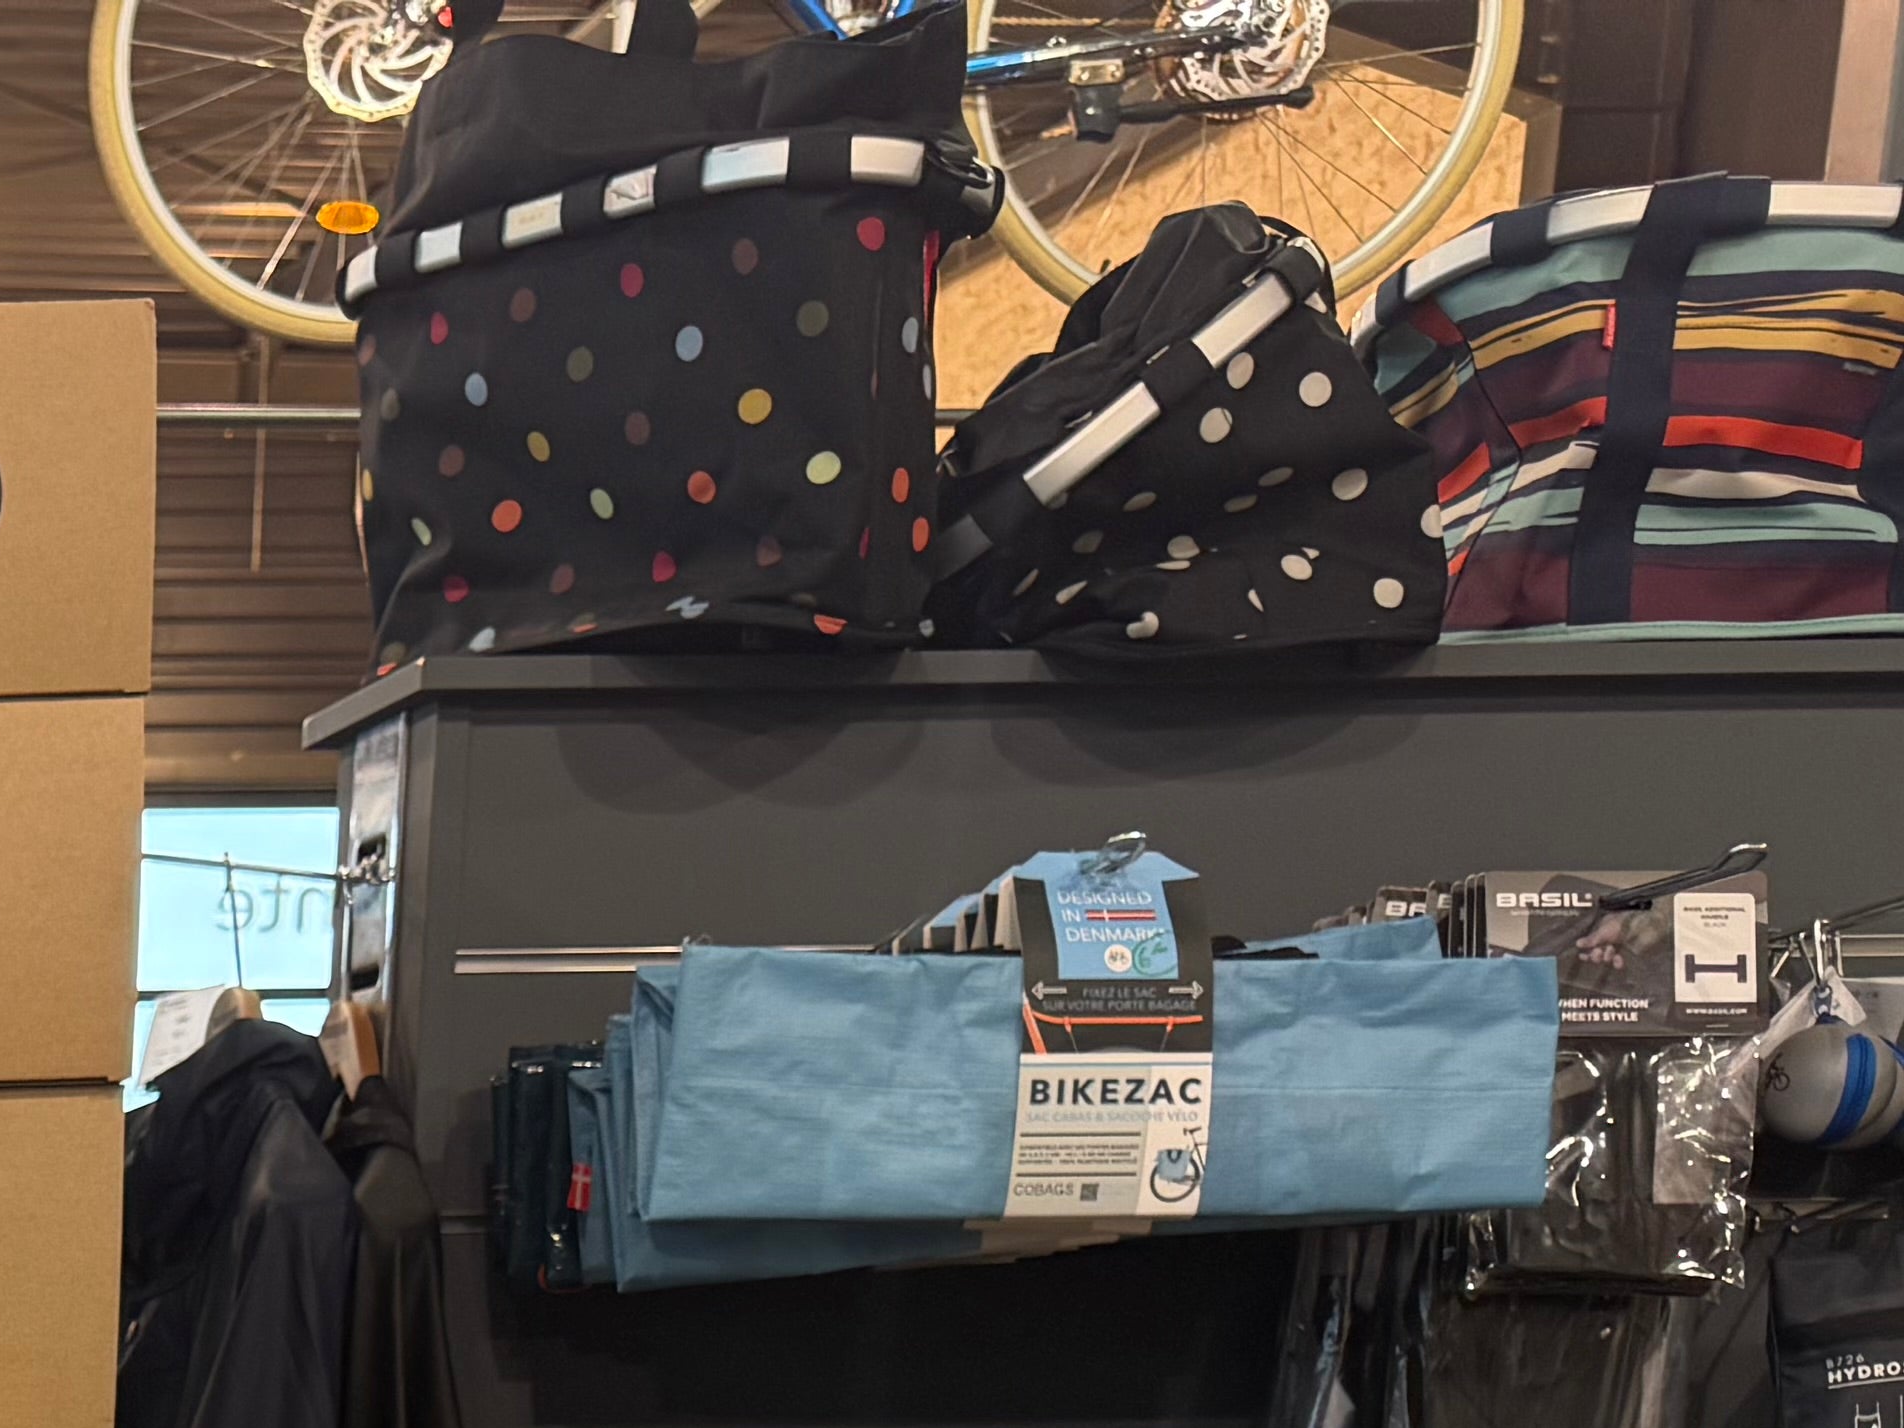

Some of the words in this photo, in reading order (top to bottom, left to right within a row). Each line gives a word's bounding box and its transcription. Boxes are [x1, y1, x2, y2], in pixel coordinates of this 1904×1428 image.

[1056, 891, 1152, 905] DESIGNED
[1496, 893, 1590, 907] BASIL
[1061, 909, 1081, 922] IN
[1589, 998, 1649, 1009] FUNCTION
[1603, 1011, 1638, 1022] STYLE
[1029, 1078, 1202, 1105] BIKEZAC
[1827, 1361, 1904, 1384] HYDRO
